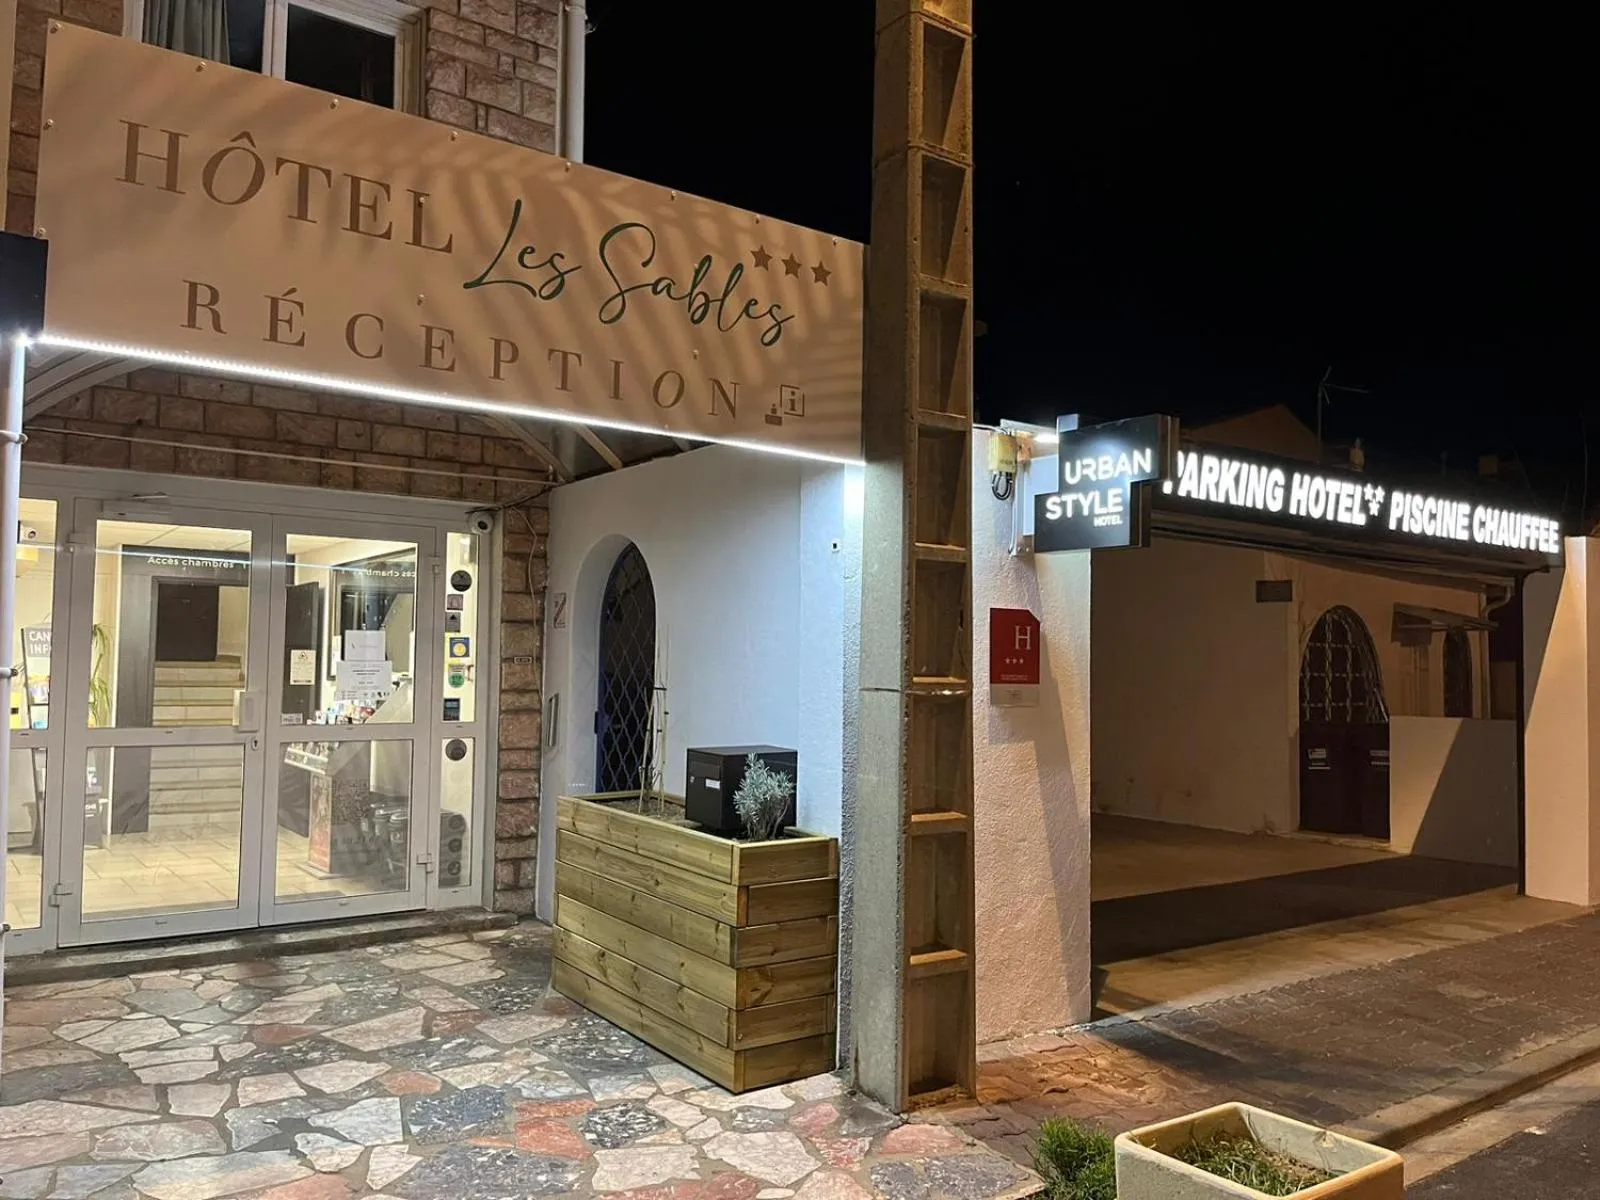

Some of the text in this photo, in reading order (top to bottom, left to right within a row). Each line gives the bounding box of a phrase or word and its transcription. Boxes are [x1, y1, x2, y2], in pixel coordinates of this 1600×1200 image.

[114, 119, 796, 347] HÔTEL Les Sables
[180, 279, 741, 420] RÉCEPTION
[1064, 448, 1152, 485] URBAN
[1045, 487, 1125, 520] STYLE
[1289, 471, 1367, 526] HOTEL
[1388, 490, 1471, 541] PISCINE
[1472, 505, 1560, 554] CHAUFFEE
[1093, 514, 1124, 528] HOTEL
[181, 557, 235, 569] chambres
[29, 631, 51, 643] CAN
[30, 643, 51, 655] INF
[1015, 625, 1031, 650] H
